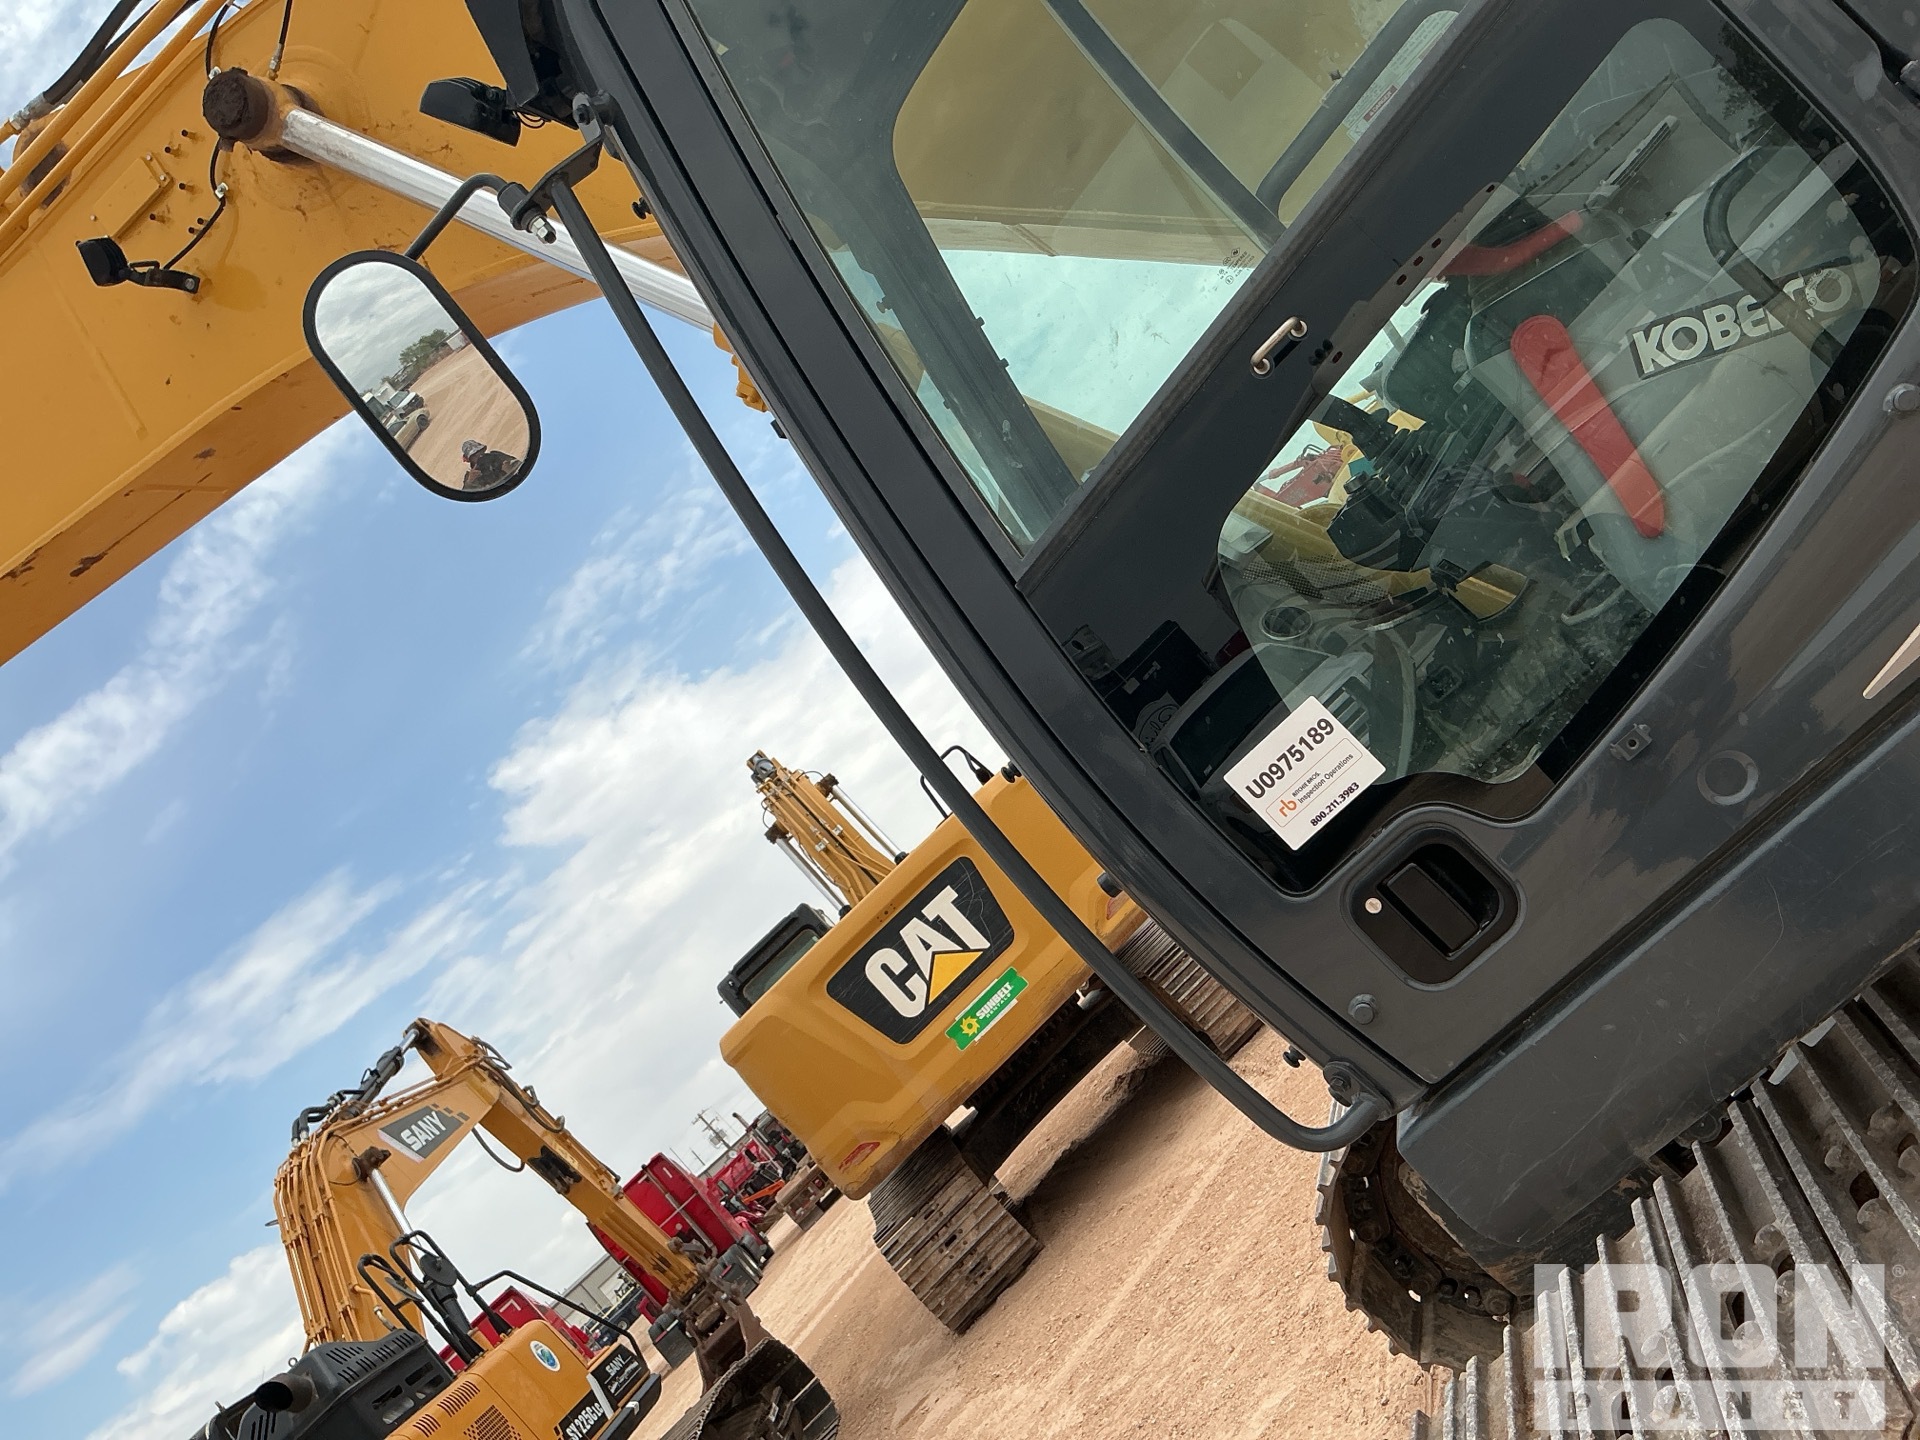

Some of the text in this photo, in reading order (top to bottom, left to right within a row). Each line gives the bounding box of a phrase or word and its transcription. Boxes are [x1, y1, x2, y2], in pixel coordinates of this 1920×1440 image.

[1633, 268, 1852, 374] KOBEO
[1245, 718, 1334, 799] U0975189
[1298, 754, 1354, 803] Inspection Operations
[1310, 782, 1360, 827] 800.211.3983
[865, 885, 991, 1018] CAT
[976, 982, 1014, 1020] SUNBELT
[986, 993, 1012, 1018] RENTALS
[400, 1111, 446, 1151] SANY
[605, 1354, 627, 1376] SANY
